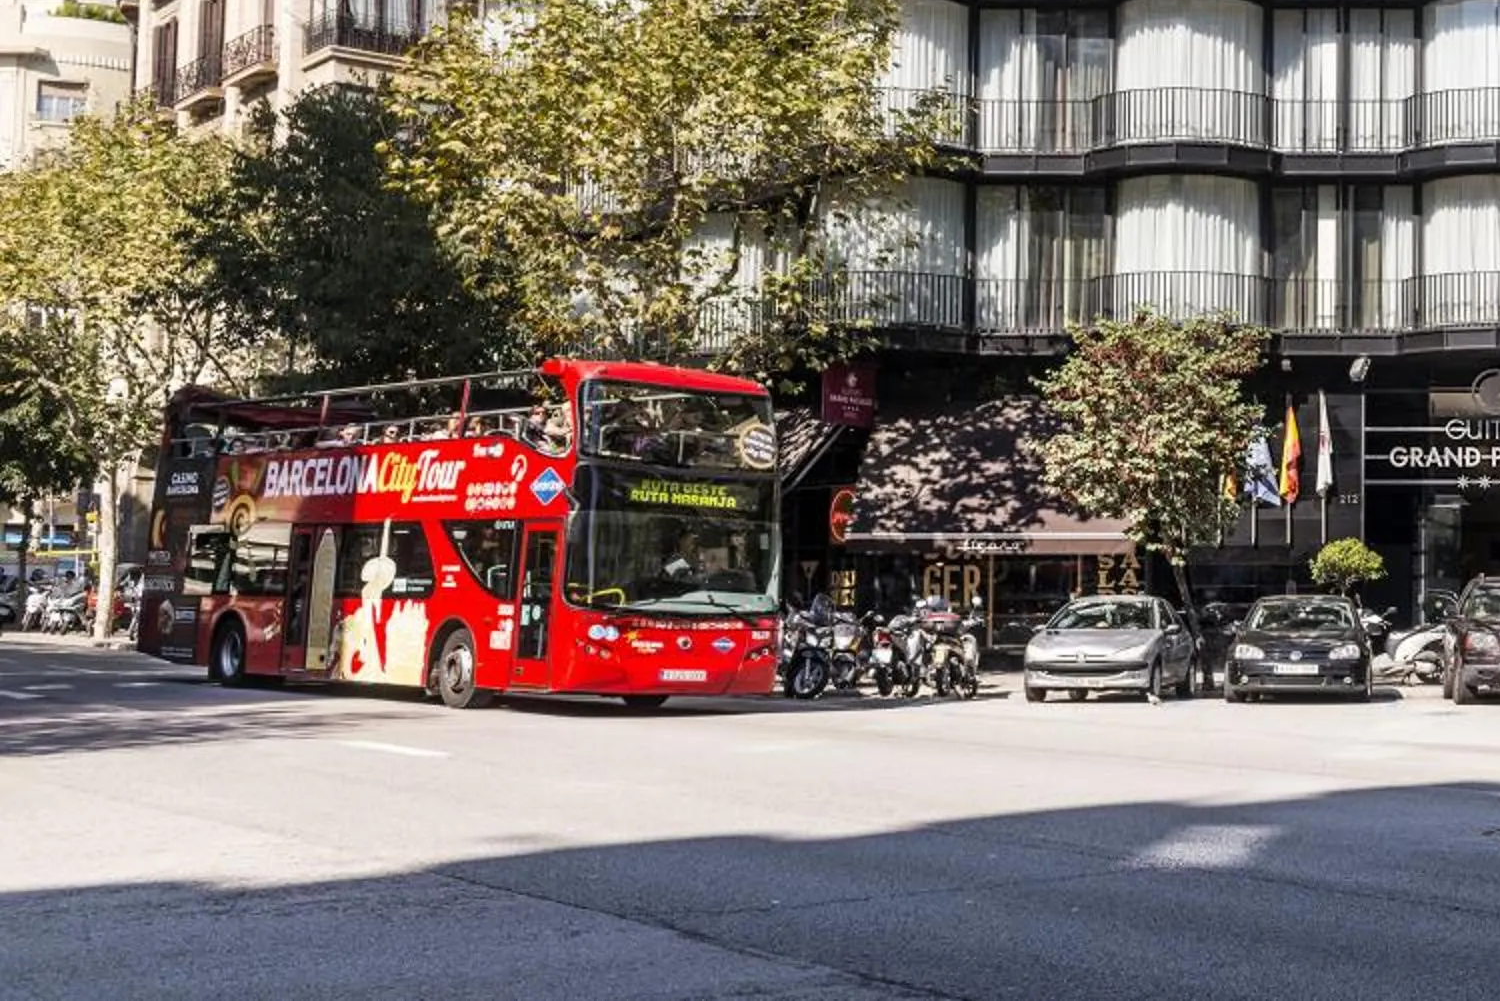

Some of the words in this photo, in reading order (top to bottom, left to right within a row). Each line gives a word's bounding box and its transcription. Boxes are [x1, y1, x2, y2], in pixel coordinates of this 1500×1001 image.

[1389, 447, 1481, 467] GRAND
[264, 454, 379, 498] BARCELONA
[631, 489, 669, 503] RUTA
[1339, 494, 1359, 504] 212
